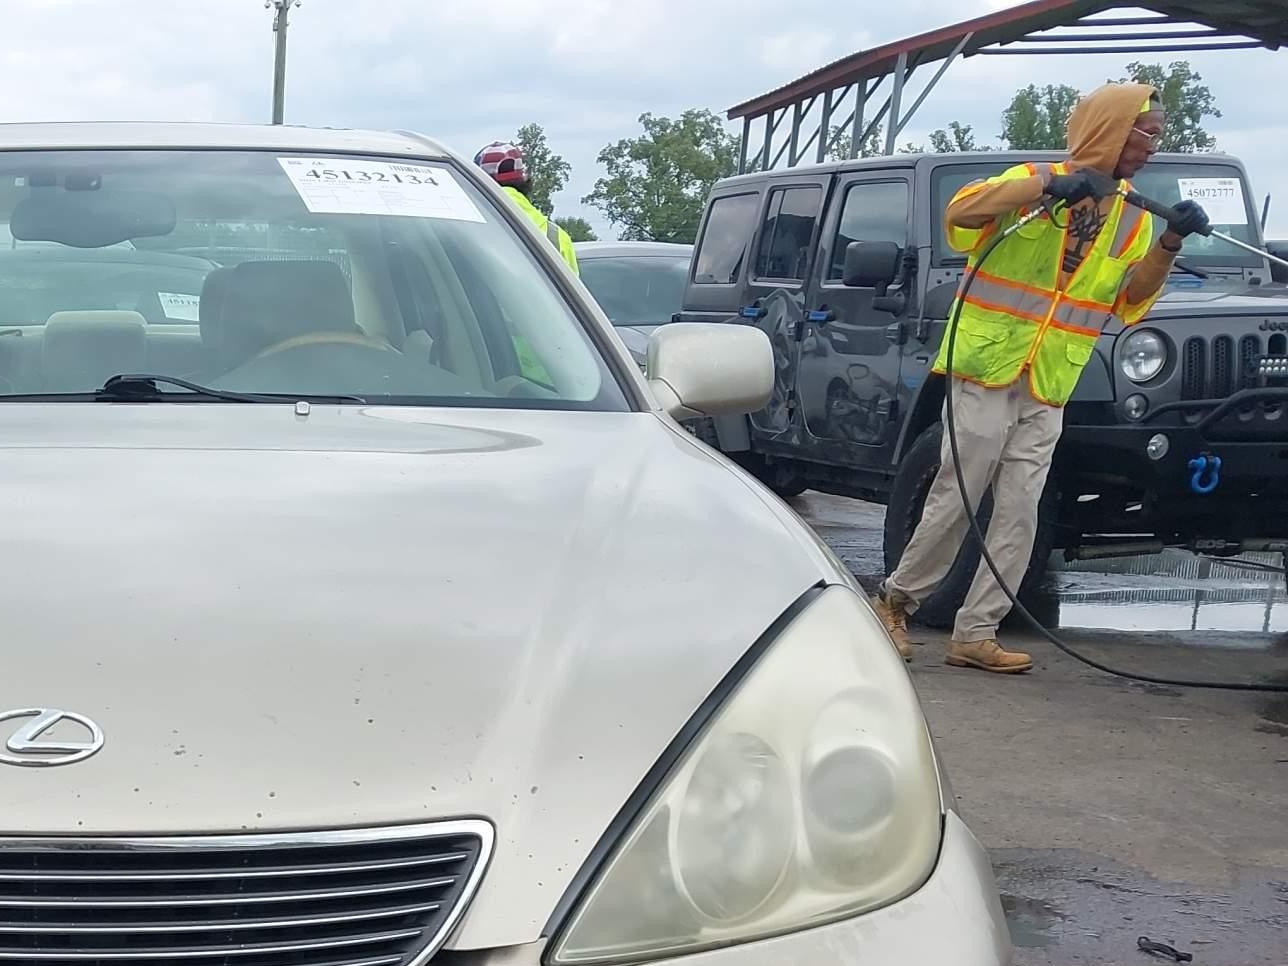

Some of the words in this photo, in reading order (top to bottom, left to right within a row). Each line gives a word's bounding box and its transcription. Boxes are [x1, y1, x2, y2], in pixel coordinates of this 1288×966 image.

[305, 168, 440, 187] 45132134
[1187, 188, 1234, 198] 45072777
[1259, 319, 1288, 333] Jee
